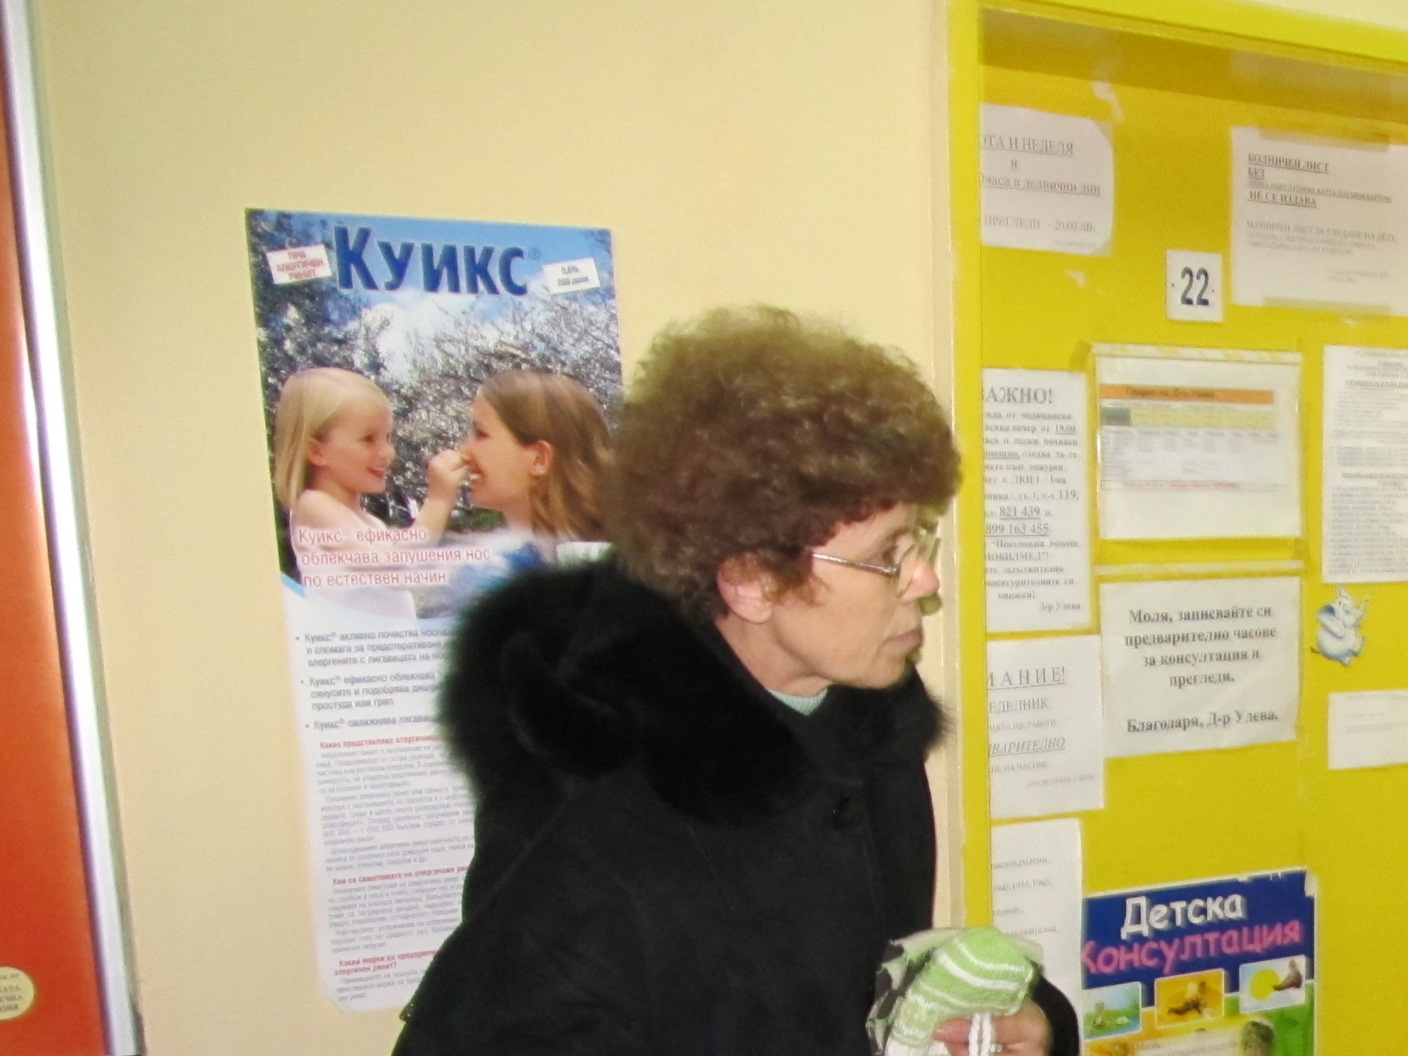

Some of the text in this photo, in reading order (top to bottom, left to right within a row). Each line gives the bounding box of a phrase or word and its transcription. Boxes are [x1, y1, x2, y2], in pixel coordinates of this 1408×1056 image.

[1248, 167, 1265, 179] БЕЗ
[1181, 266, 1209, 305] 22
[982, 386, 1053, 405] АЖНО!
[999, 506, 1018, 519] 821
[1021, 506, 1040, 519] 439
[1008, 523, 1026, 536] 163
[301, 547, 490, 566] облекчава запушения нос
[327, 573, 400, 587] естествен
[404, 572, 447, 583] начин
[1129, 605, 1272, 624] Моля, записвайте си
[1125, 627, 1277, 649] предварително часове
[1143, 650, 1260, 667] за консултация и
[1169, 672, 1235, 689] прегледи.
[1127, 709, 1278, 733] Благодаря, Д-р Удева.
[1121, 893, 1246, 940] Детска
